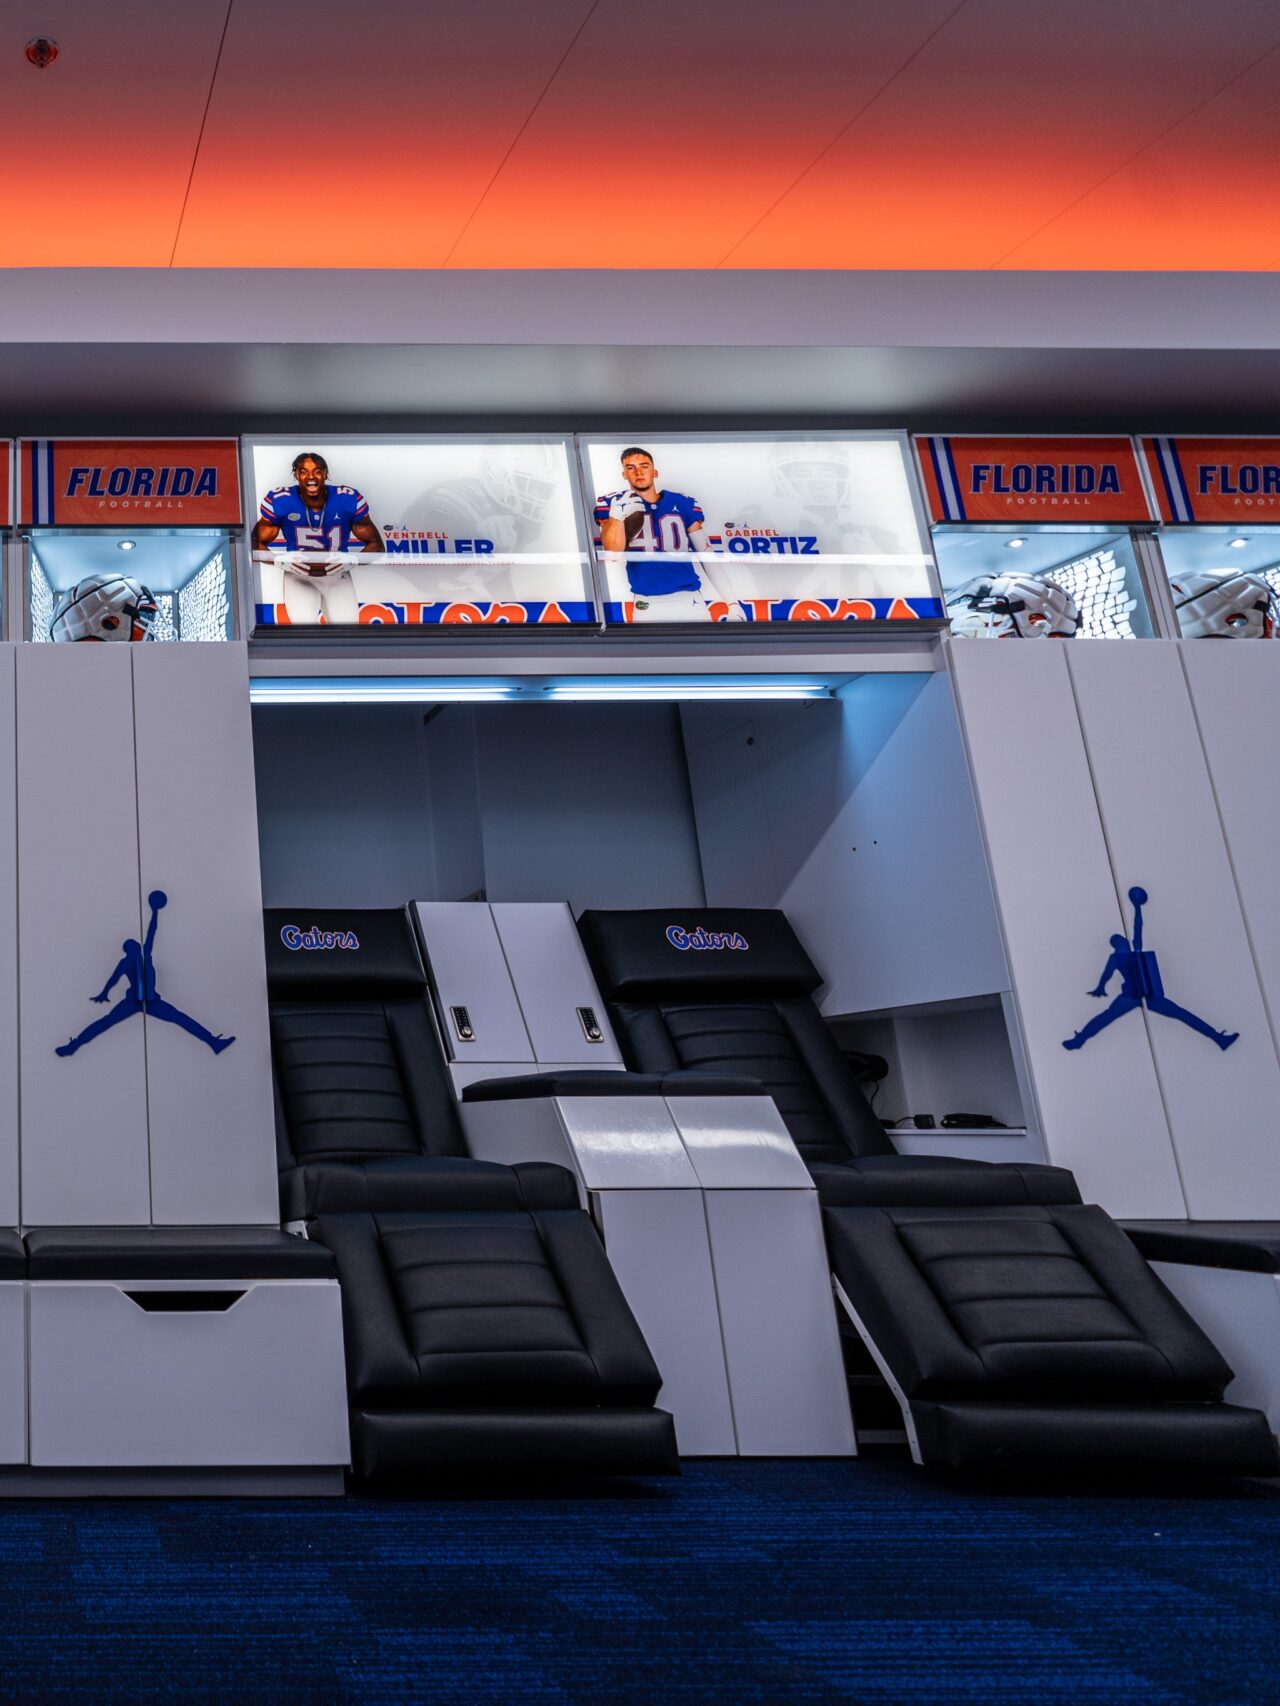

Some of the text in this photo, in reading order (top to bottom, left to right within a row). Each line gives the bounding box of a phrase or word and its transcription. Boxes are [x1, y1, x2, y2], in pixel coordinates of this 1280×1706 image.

[64, 466, 219, 498] FLORIDA
[969, 463, 1121, 494] FLORIDA
[98, 500, 184, 508] FOOTBALL
[384, 531, 449, 539] VENTRELL
[725, 529, 780, 537] GABRIEL
[385, 539, 495, 558] MILLER
[728, 536, 820, 555] ORTIZ
[280, 924, 360, 951] Gators
[665, 925, 749, 951] Gators
